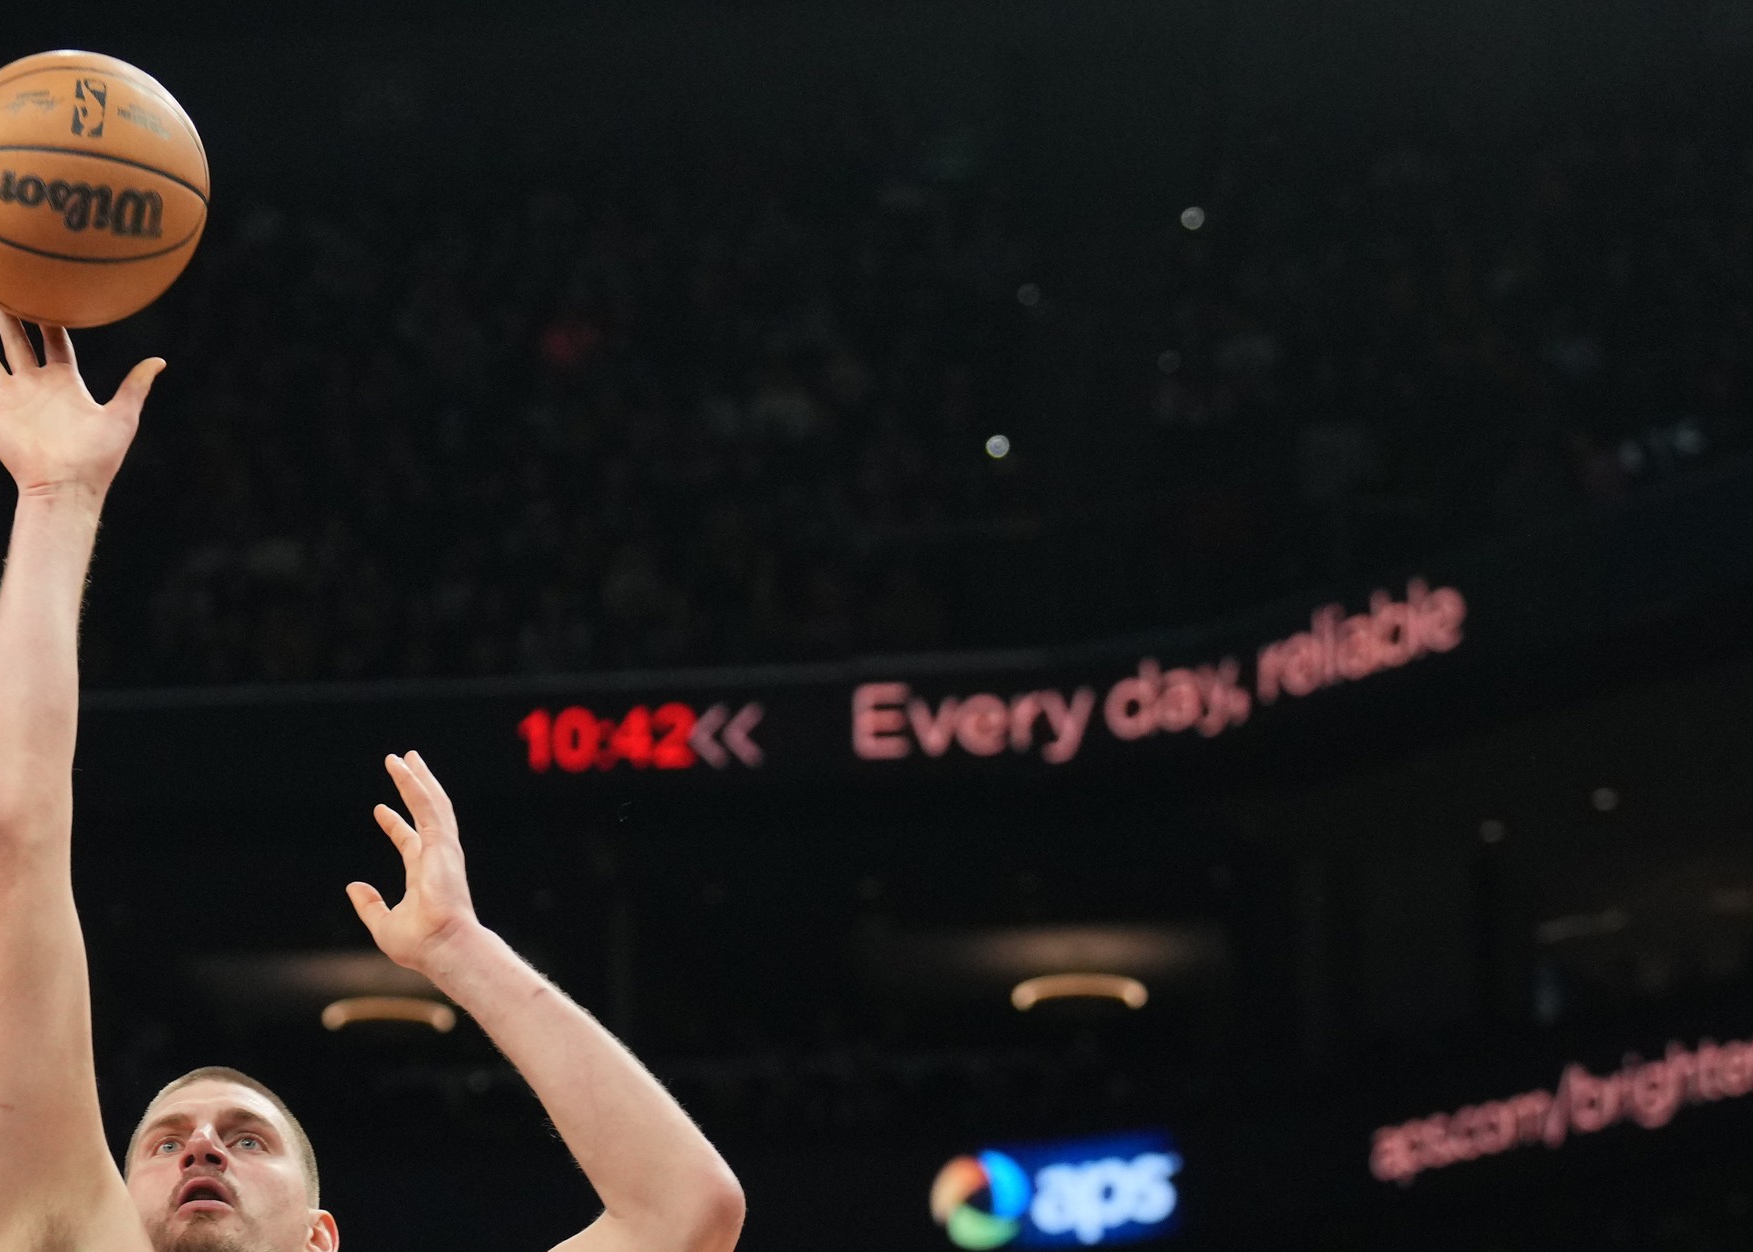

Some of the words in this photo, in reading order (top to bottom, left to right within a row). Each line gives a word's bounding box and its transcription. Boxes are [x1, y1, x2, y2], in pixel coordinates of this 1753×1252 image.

[853, 681, 1095, 764] Every
[1103, 657, 1252, 741] day,
[1256, 578, 1466, 702] reliable
[518, 702, 698, 774] 10:42
[1031, 1152, 1182, 1245] aps
